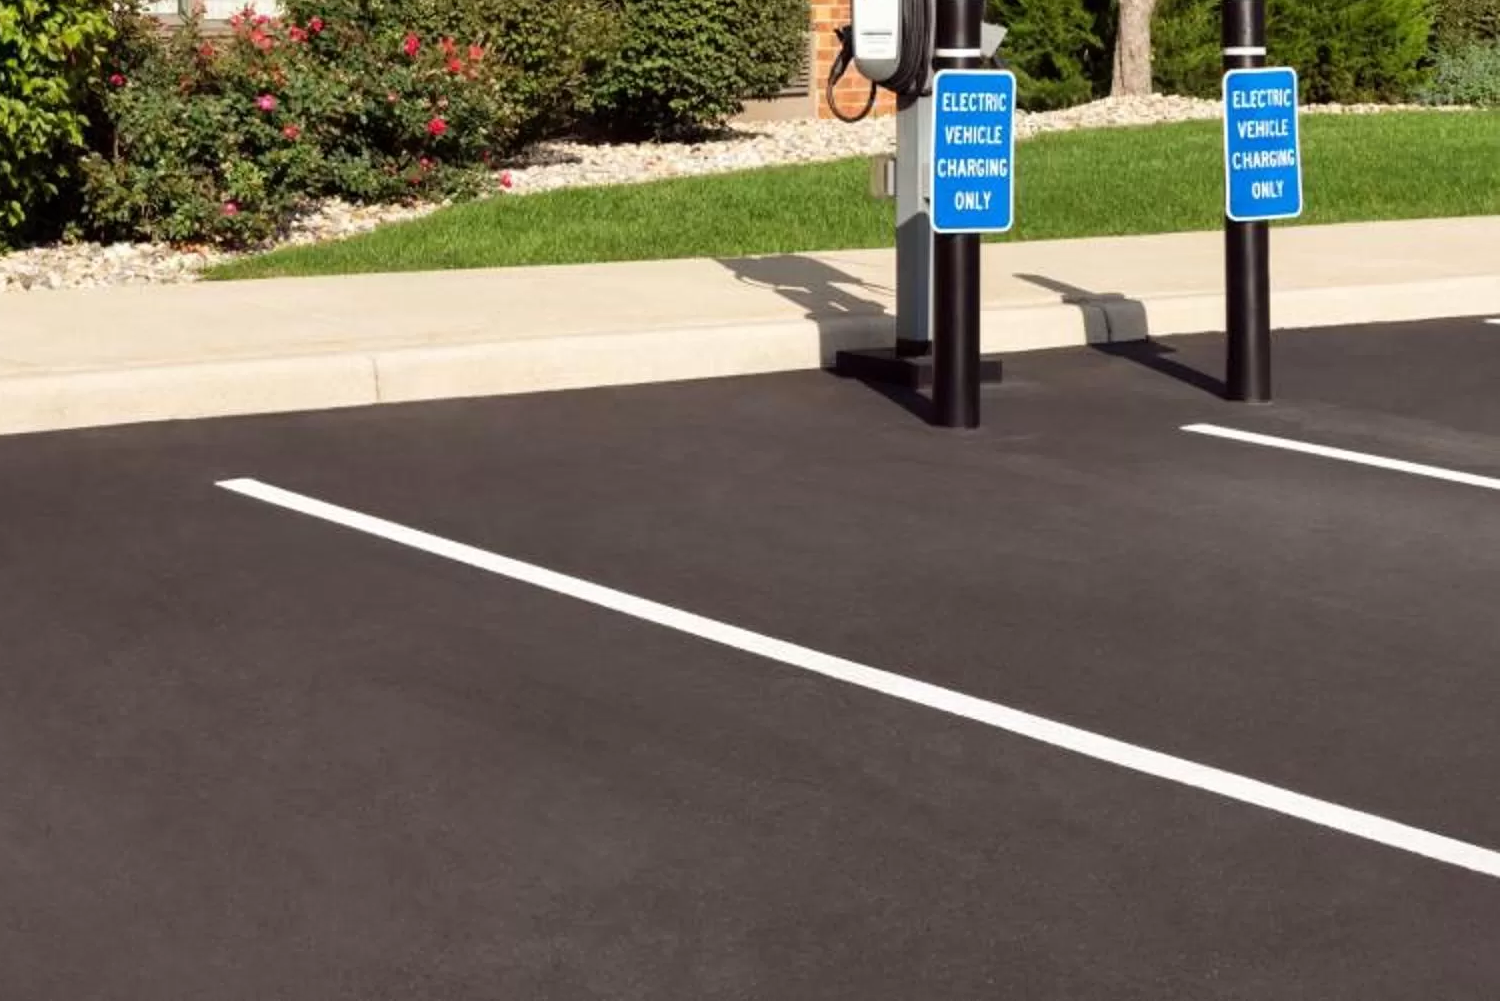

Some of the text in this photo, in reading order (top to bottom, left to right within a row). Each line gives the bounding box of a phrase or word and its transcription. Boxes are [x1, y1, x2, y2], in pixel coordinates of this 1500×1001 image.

[942, 92, 1007, 112] ELECTRIC
[1232, 88, 1292, 108] ELECTRIC
[945, 125, 1003, 144] VEHICLE
[1237, 119, 1289, 139] VEHICLE
[937, 158, 1008, 178] CHARGING
[1231, 149, 1295, 170] CHARGING
[1251, 180, 1284, 199] ONLY
[954, 190, 992, 210] ONLY
